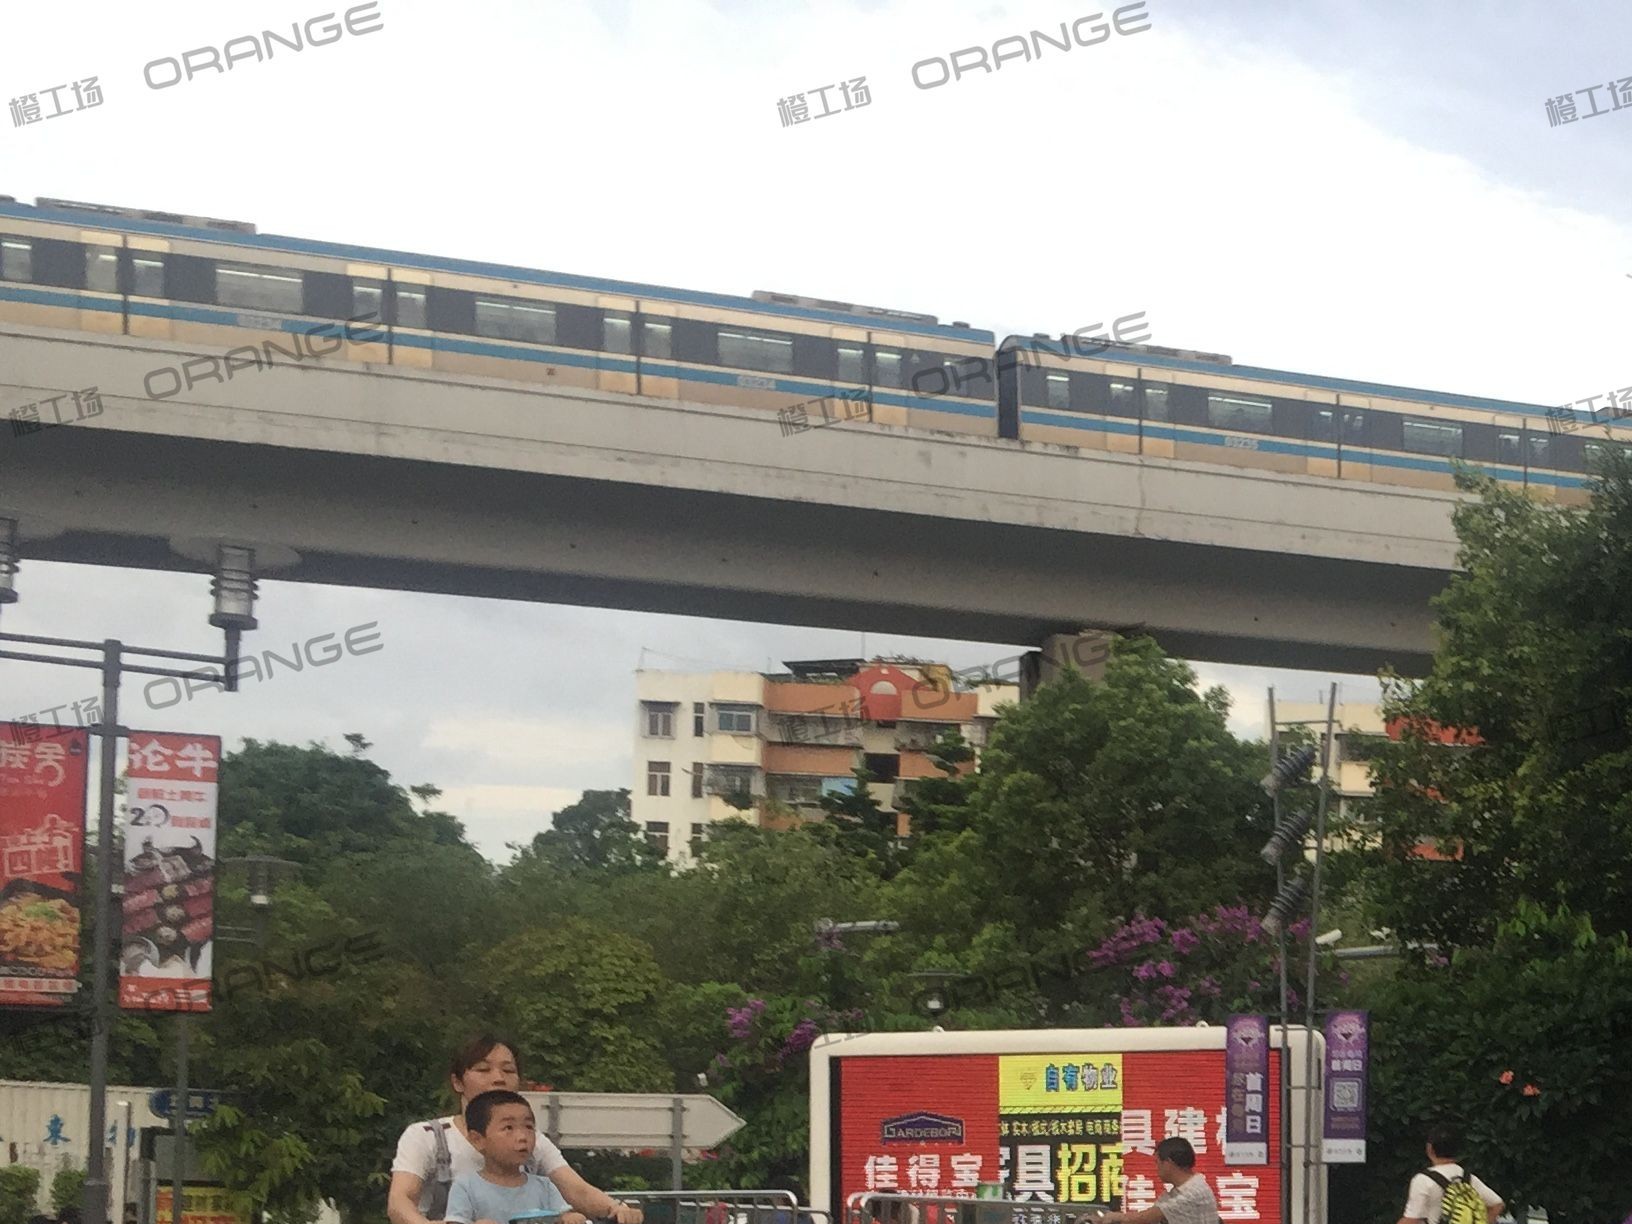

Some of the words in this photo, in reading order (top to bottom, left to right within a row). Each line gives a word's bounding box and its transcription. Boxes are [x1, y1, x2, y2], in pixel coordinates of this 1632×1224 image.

[1045, 1062, 1118, 1092] 自有物业
[1121, 1107, 1227, 1156] 具建
[864, 1153, 983, 1189] 佳得宝
[999, 1143, 1124, 1203] 具招商
[1121, 1170, 1260, 1220] 佳宝
